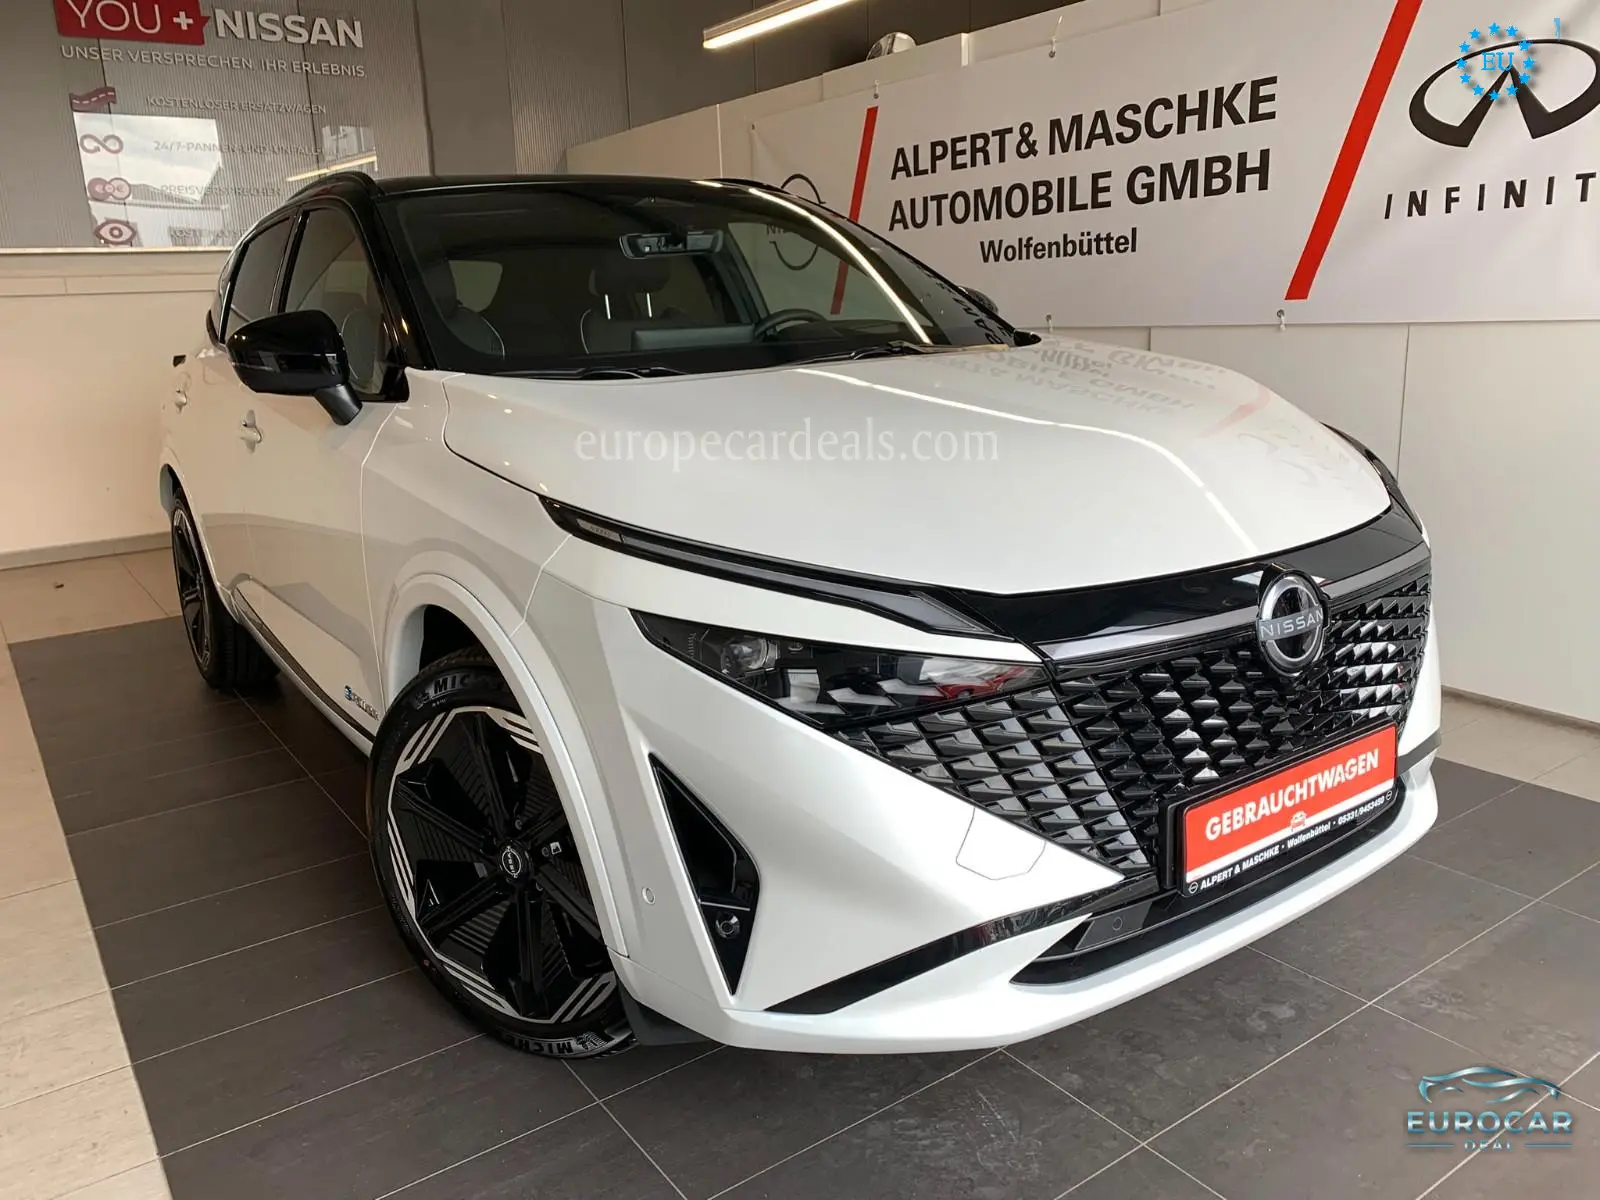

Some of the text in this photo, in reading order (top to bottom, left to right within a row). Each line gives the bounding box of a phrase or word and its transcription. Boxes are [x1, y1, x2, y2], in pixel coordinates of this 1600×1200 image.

[66, 0, 161, 34] YOU
[214, 8, 364, 48] NISSAN
[61, 45, 122, 61] UNSER
[261, 59, 287, 72] IHR
[146, 96, 327, 114] KOSTENLOSER ERSATZWAGEN
[1048, 76, 1278, 156] MASCHKE
[888, 148, 1270, 232] AUTOMOBILE GMBH
[1384, 172, 1597, 220] INFINIT
[980, 227, 1138, 264] Wolfenbüttel
[1260, 607, 1324, 638] NISSAN
[1205, 748, 1379, 840] GEBRAUCHTWAGEN
[1200, 867, 1234, 890] ALPERT
[1234, 863, 1241, 875] &
[1242, 844, 1280, 871] MASCHKE
[1287, 821, 1331, 849] Wolfenbüttel
